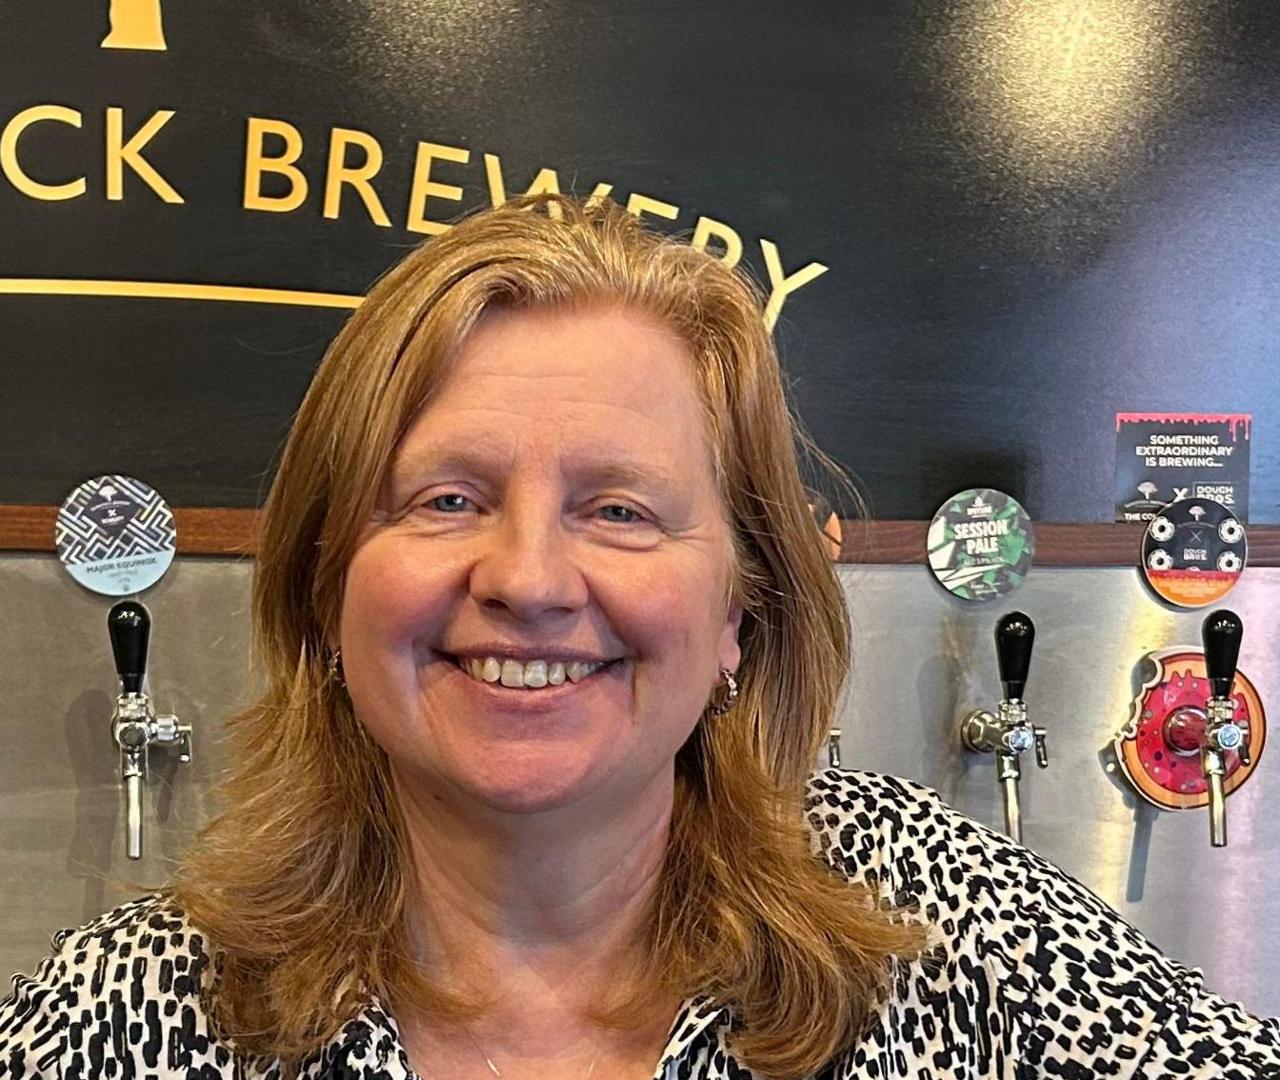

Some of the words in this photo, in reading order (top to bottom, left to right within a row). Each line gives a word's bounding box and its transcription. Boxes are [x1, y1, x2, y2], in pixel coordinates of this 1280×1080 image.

[1149, 434, 1219, 446] SOMETHING
[1135, 446, 1233, 456] EXTRAORDINARY
[1145, 457, 1157, 467] IS
[1196, 485, 1234, 495] DOUGH
[1124, 512, 1141, 521] THE
[953, 519, 1009, 540] SESSION
[966, 536, 999, 555] PALE
[86, 562, 116, 574] MAJOR
[116, 557, 158, 569] EQUINOX
